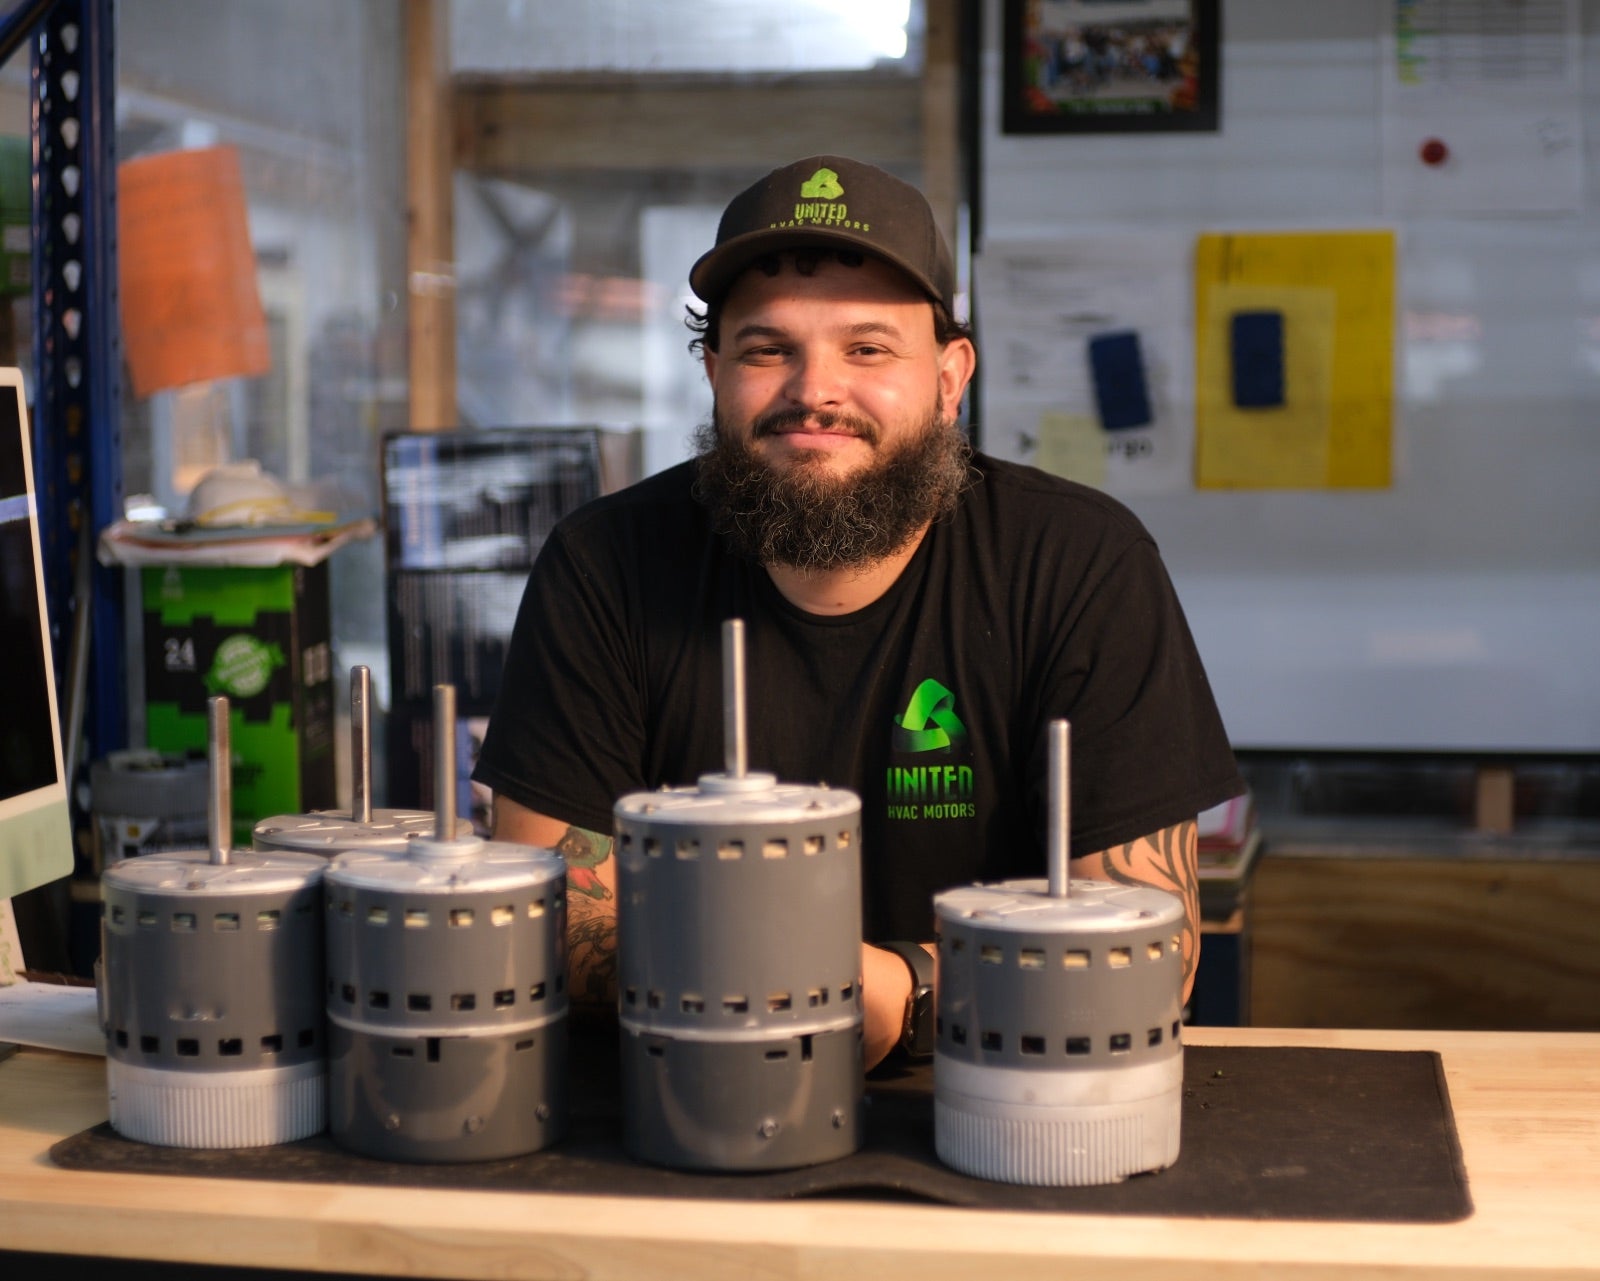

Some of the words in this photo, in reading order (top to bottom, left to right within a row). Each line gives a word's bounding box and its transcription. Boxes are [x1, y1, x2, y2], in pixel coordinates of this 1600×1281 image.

[795, 203, 848, 220] UNITED
[770, 219, 805, 229] HVAC
[811, 218, 871, 232] MOTORS
[163, 637, 196, 665] 24
[886, 765, 974, 802] UNITED
[888, 805, 918, 820] HVAC
[923, 803, 976, 819] MOTORS
